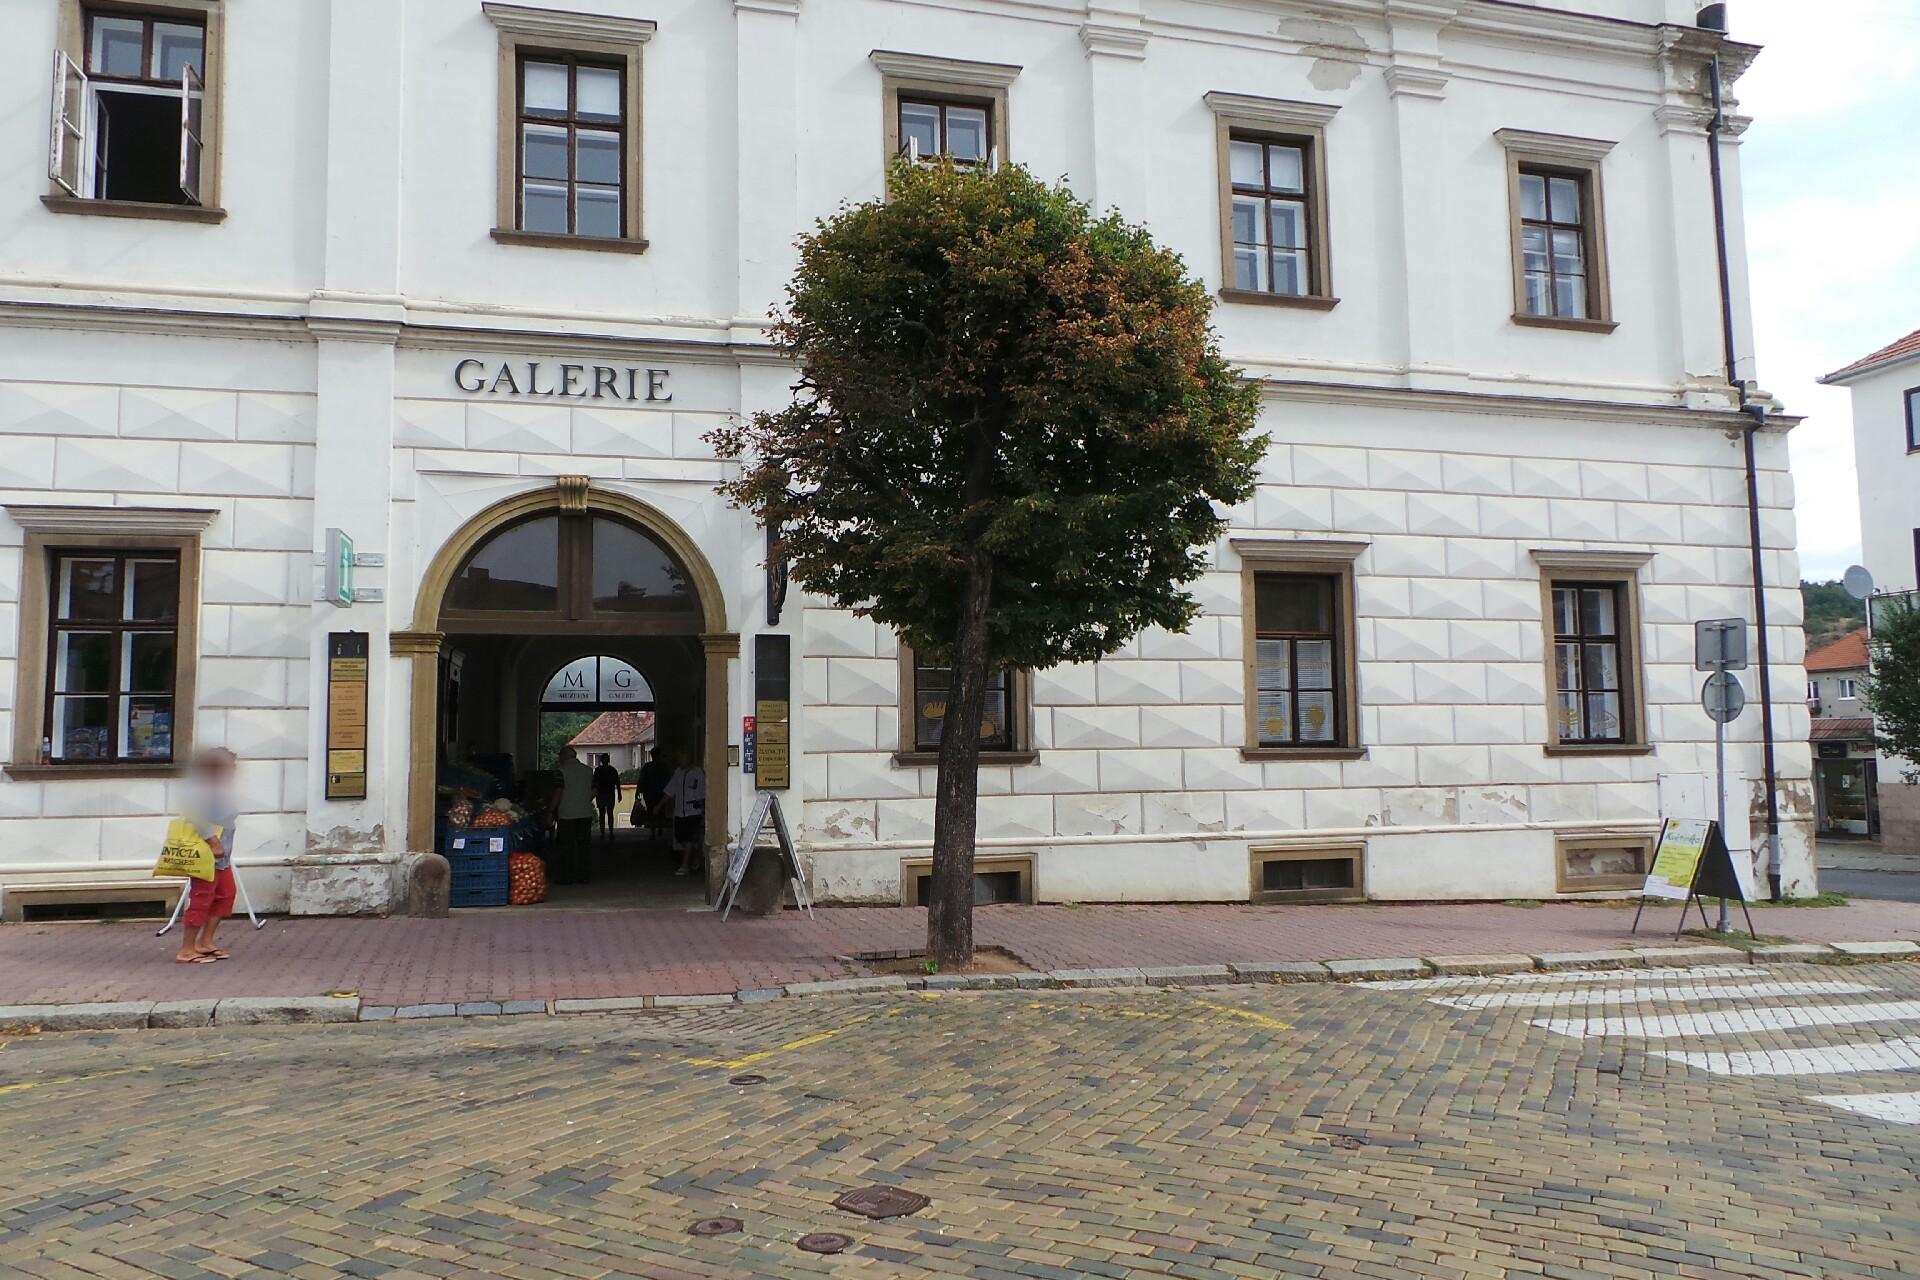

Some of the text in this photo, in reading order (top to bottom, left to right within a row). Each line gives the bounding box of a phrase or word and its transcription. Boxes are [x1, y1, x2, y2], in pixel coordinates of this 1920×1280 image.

[454, 358, 673, 401] GALERIE
[563, 670, 585, 688] M
[614, 669, 632, 688] G
[161, 846, 201, 859] INVICTA
